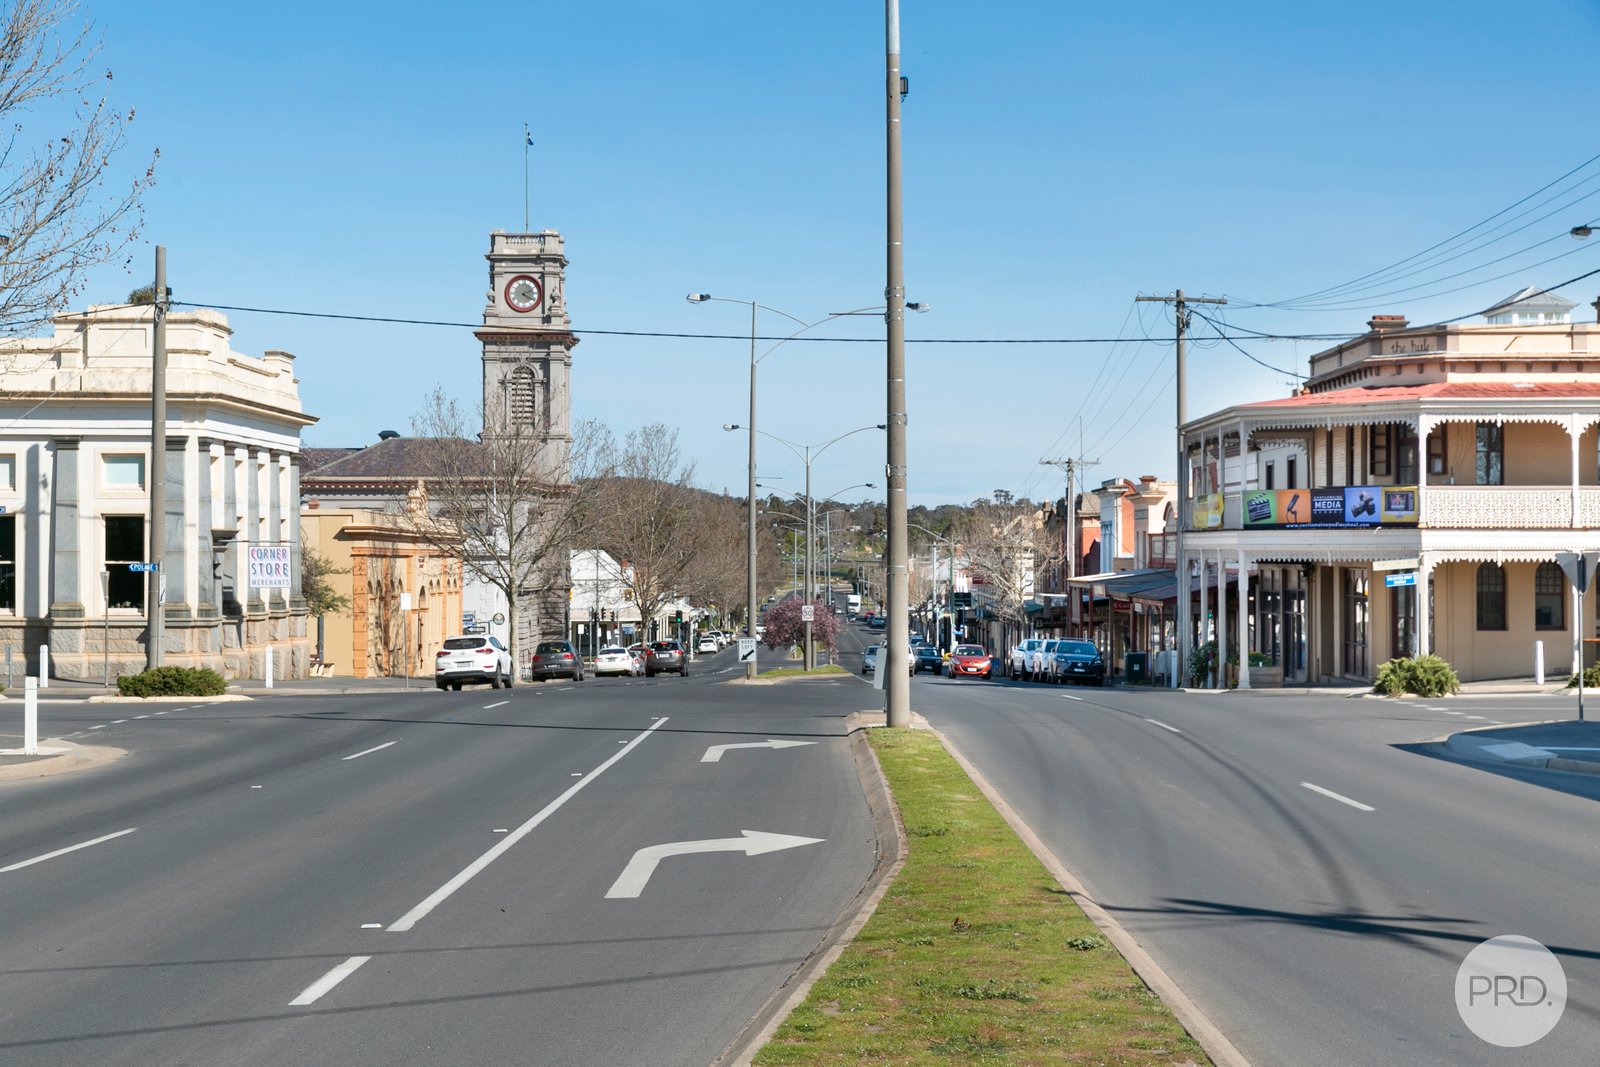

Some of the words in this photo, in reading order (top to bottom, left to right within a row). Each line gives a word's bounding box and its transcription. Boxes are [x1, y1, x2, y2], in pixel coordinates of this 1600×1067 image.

[1391, 341, 1406, 353] the
[1314, 501, 1342, 509] MEDIA
[251, 548, 288, 561] CORNER
[251, 563, 289, 577] STORE
